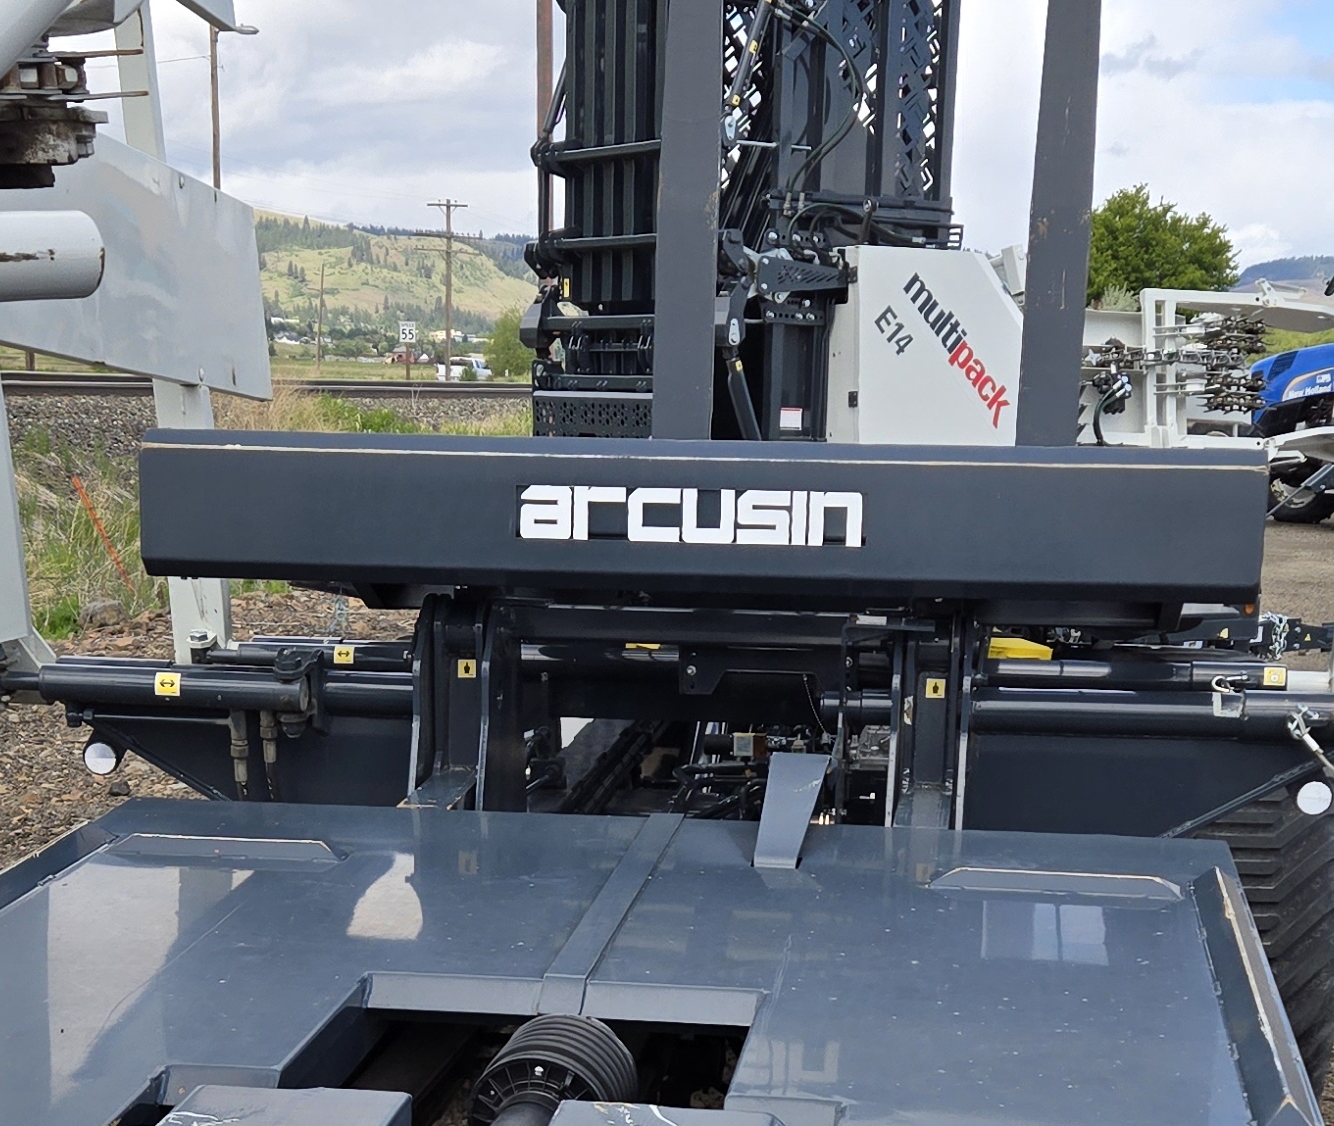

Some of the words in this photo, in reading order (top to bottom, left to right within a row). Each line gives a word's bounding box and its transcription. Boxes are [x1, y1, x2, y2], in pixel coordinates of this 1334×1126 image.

[401, 328, 414, 340] 55
[874, 305, 914, 356] E14
[903, 272, 1010, 429] multipack
[1305, 383, 1332, 396] Holland
[520, 484, 863, 547] arcusin
